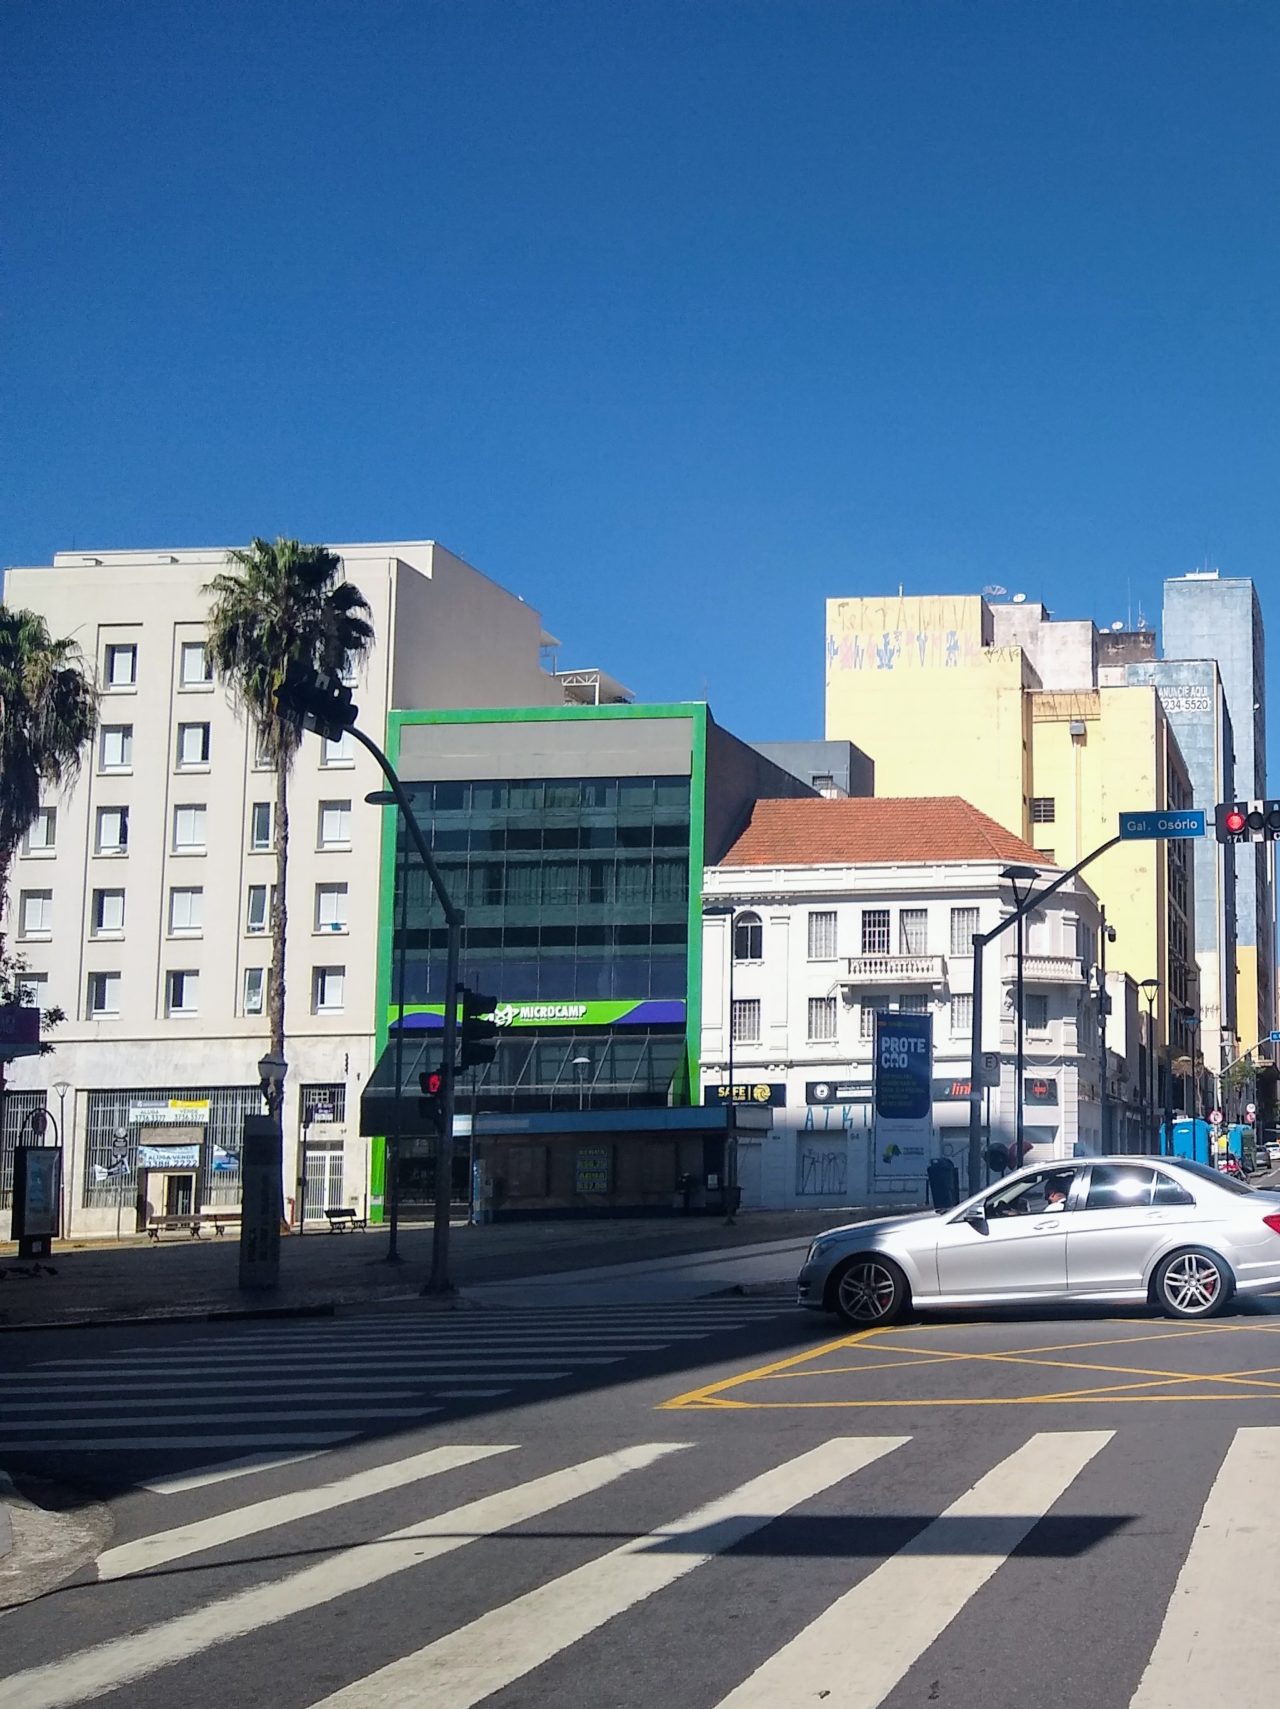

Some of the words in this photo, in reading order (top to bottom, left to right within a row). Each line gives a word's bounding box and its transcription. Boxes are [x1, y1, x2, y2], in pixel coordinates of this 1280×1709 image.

[1159, 685, 1190, 698] ANUNCIE
[1191, 685, 1208, 698] AQUI
[1162, 699, 1209, 710] 234-5520
[1127, 820, 1152, 832] Gal.
[1158, 818, 1198, 831] Osório
[520, 1005, 587, 1019] MICROCAMP
[881, 1036, 926, 1053] PROTE
